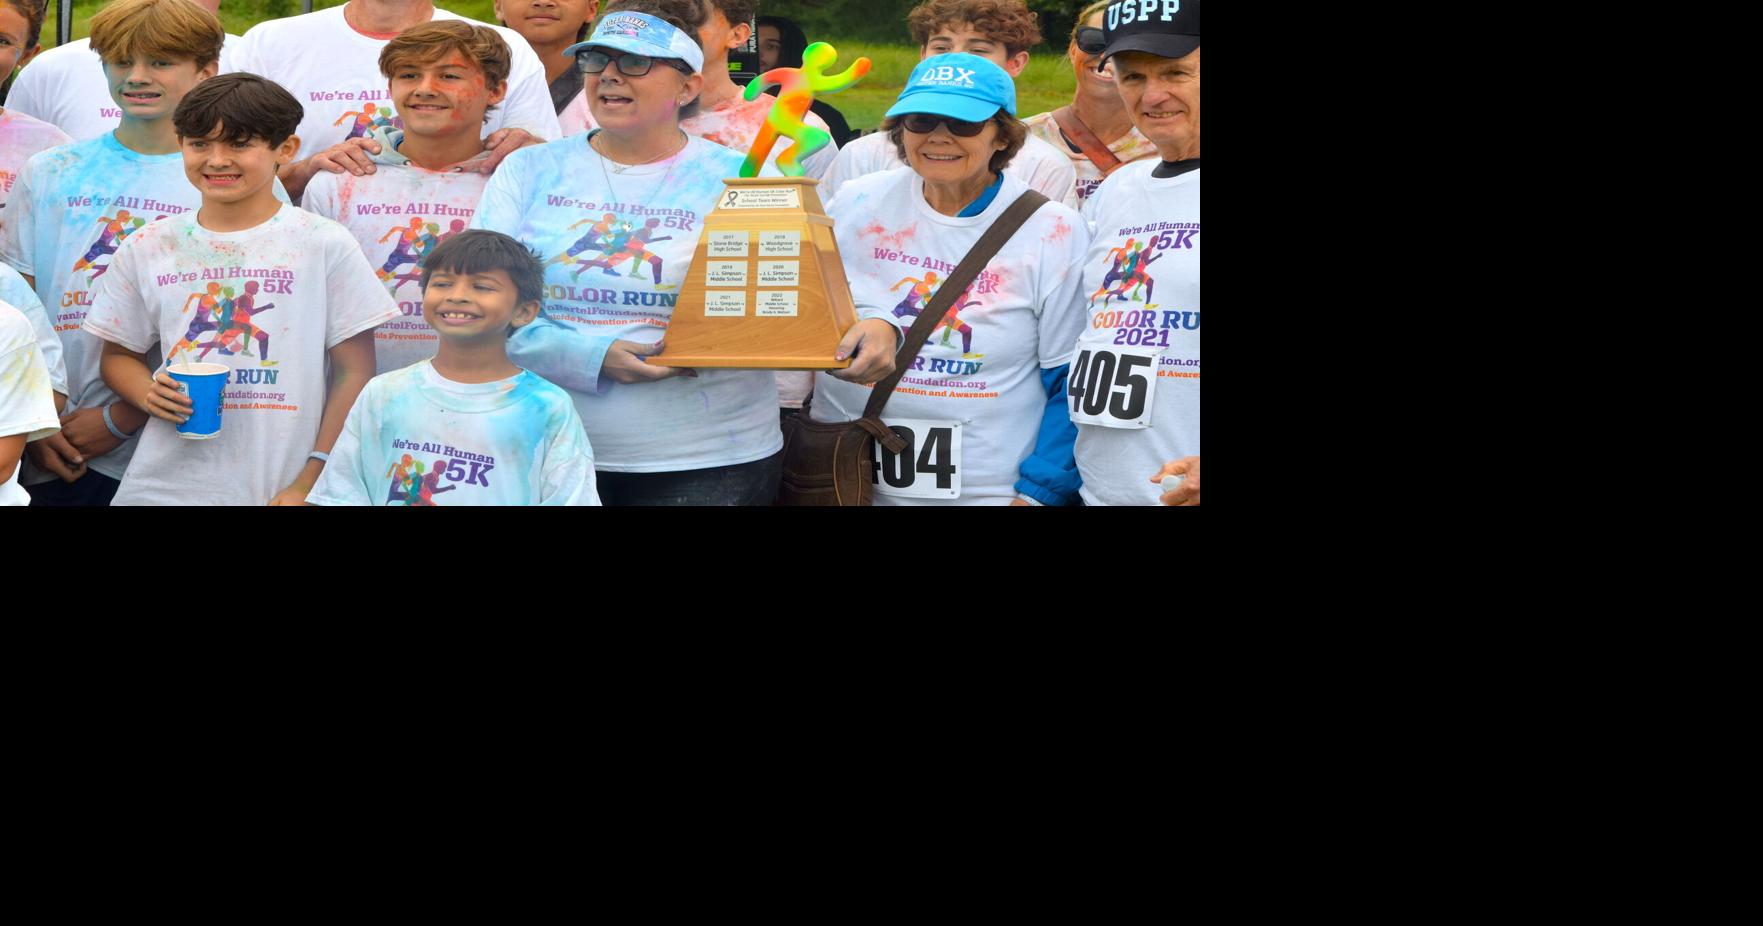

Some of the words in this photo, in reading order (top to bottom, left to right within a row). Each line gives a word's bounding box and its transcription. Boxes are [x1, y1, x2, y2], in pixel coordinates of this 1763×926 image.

[1107, 0, 1180, 31] USPP
[310, 90, 354, 102] We're
[358, 90, 381, 100] All
[113, 195, 138, 209] All
[357, 204, 401, 216] We're
[405, 203, 429, 215] All
[433, 204, 475, 217] Hum
[547, 194, 596, 210] We're
[600, 202, 625, 214] All
[628, 204, 696, 219] Human
[664, 216, 695, 232] 5K
[1119, 225, 1142, 237] We're
[1143, 223, 1157, 233] All
[1157, 229, 1199, 250] 5K
[874, 247, 919, 266] We're
[922, 256, 945, 273] All
[156, 271, 197, 287] We're
[201, 267, 224, 280] All
[228, 266, 295, 280] Human
[263, 280, 294, 295] 5K
[61, 290, 96, 308] COL
[622, 290, 679, 307] RUN
[577, 316, 628, 327] Prevention
[1093, 309, 1157, 329] COLOR
[1160, 310, 1200, 330] RU
[1113, 327, 1170, 347] 2021
[928, 357, 983, 376] RUN
[235, 369, 279, 385] RUN
[902, 375, 987, 391] oundation.org
[1068, 350, 1152, 420] 405
[928, 389, 946, 397] and
[949, 390, 998, 399] Awareness
[421, 442, 441, 454] All
[443, 445, 495, 465] Human
[445, 459, 495, 487] 5K
